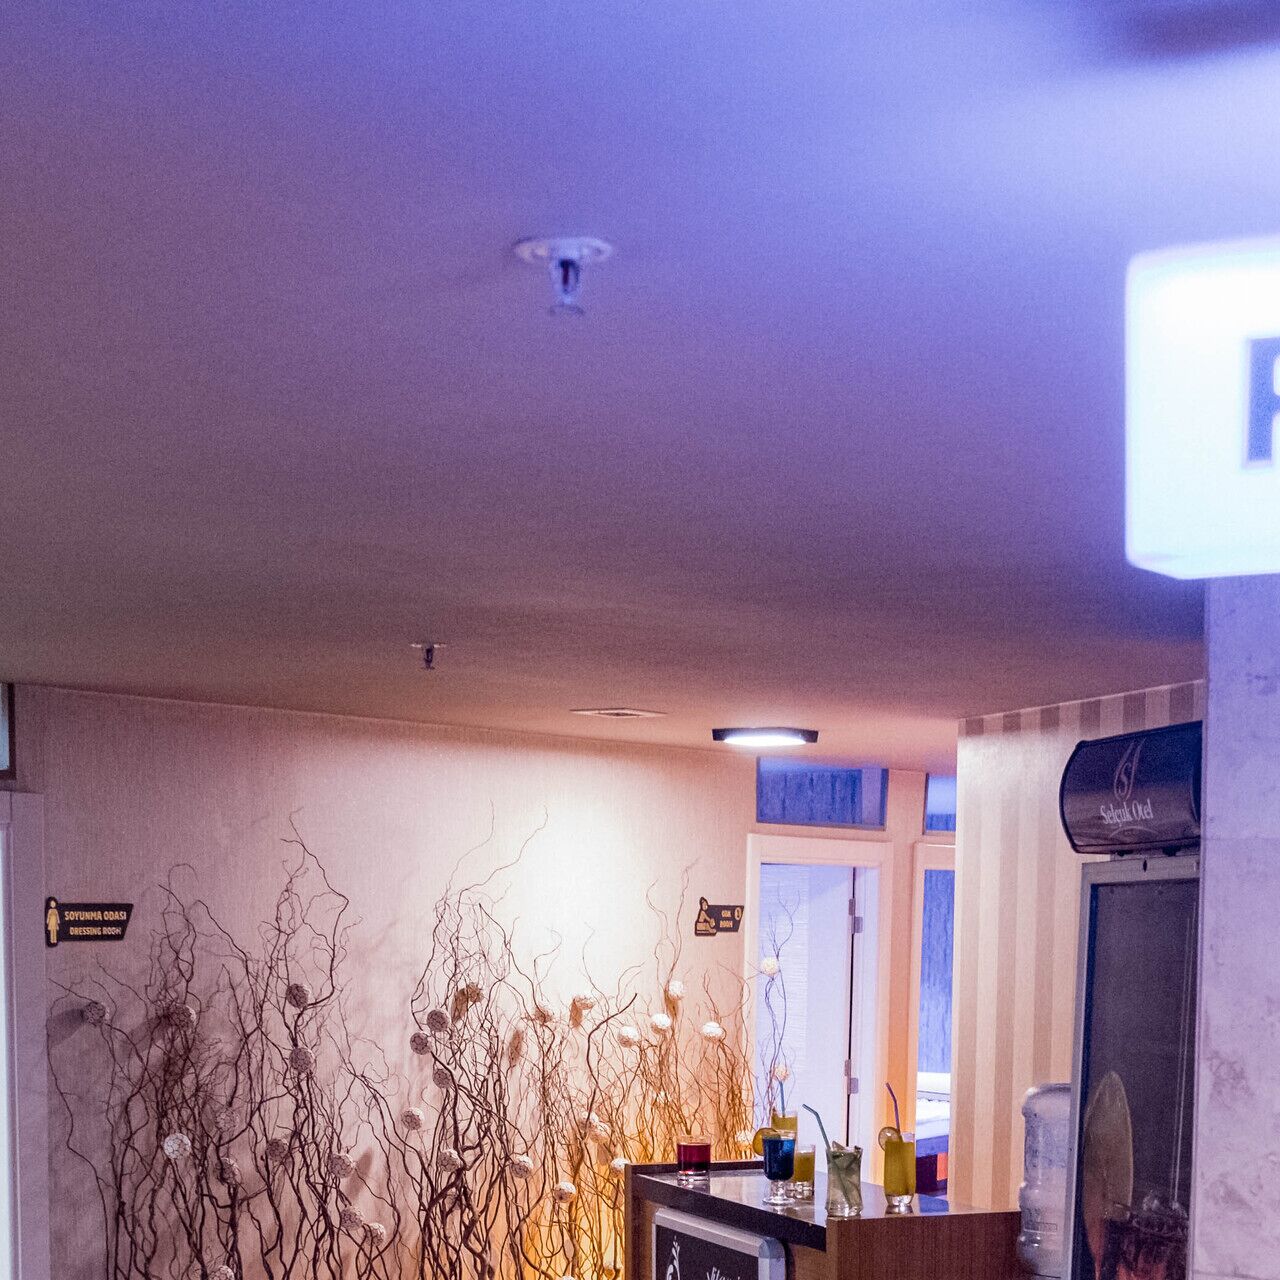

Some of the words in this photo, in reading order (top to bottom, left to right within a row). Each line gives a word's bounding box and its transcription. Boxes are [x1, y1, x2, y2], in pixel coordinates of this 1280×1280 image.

[64, 911, 102, 920] SOYUNMA
[103, 911, 127, 920] ODASI
[69, 927, 102, 936] DRESSING
[102, 927, 122, 935] ROOM
